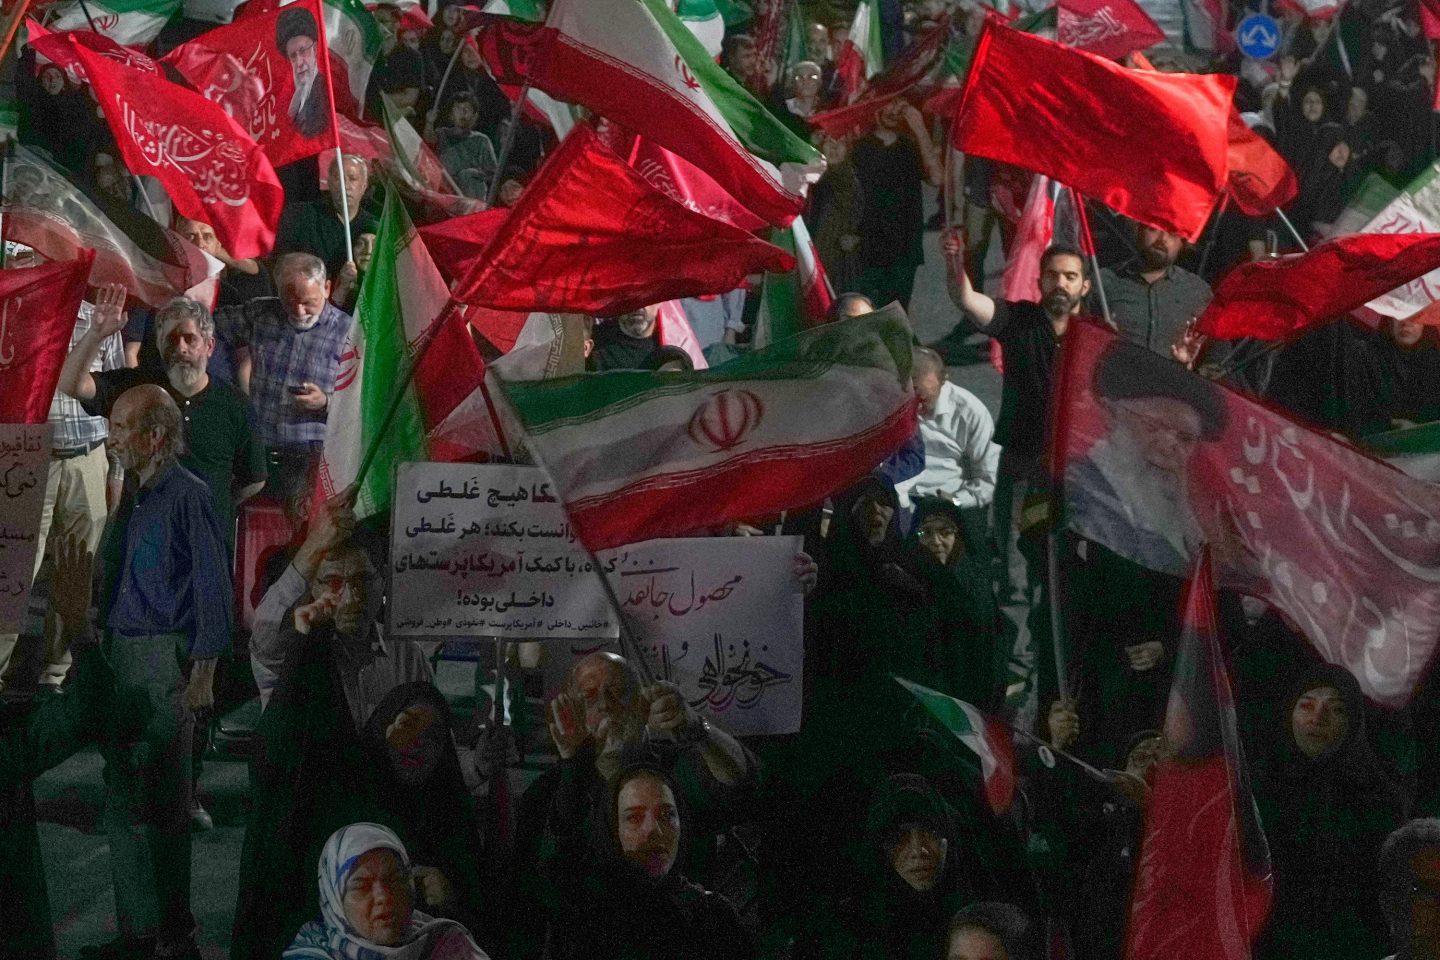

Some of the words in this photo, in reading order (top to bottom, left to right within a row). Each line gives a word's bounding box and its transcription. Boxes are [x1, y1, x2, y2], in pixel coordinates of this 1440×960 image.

[487, 484, 528, 508] هیچ
[459, 524, 482, 539] هر
[524, 554, 563, 574] کمک
[564, 556, 576, 577] با
[494, 590, 555, 613] داخلی
